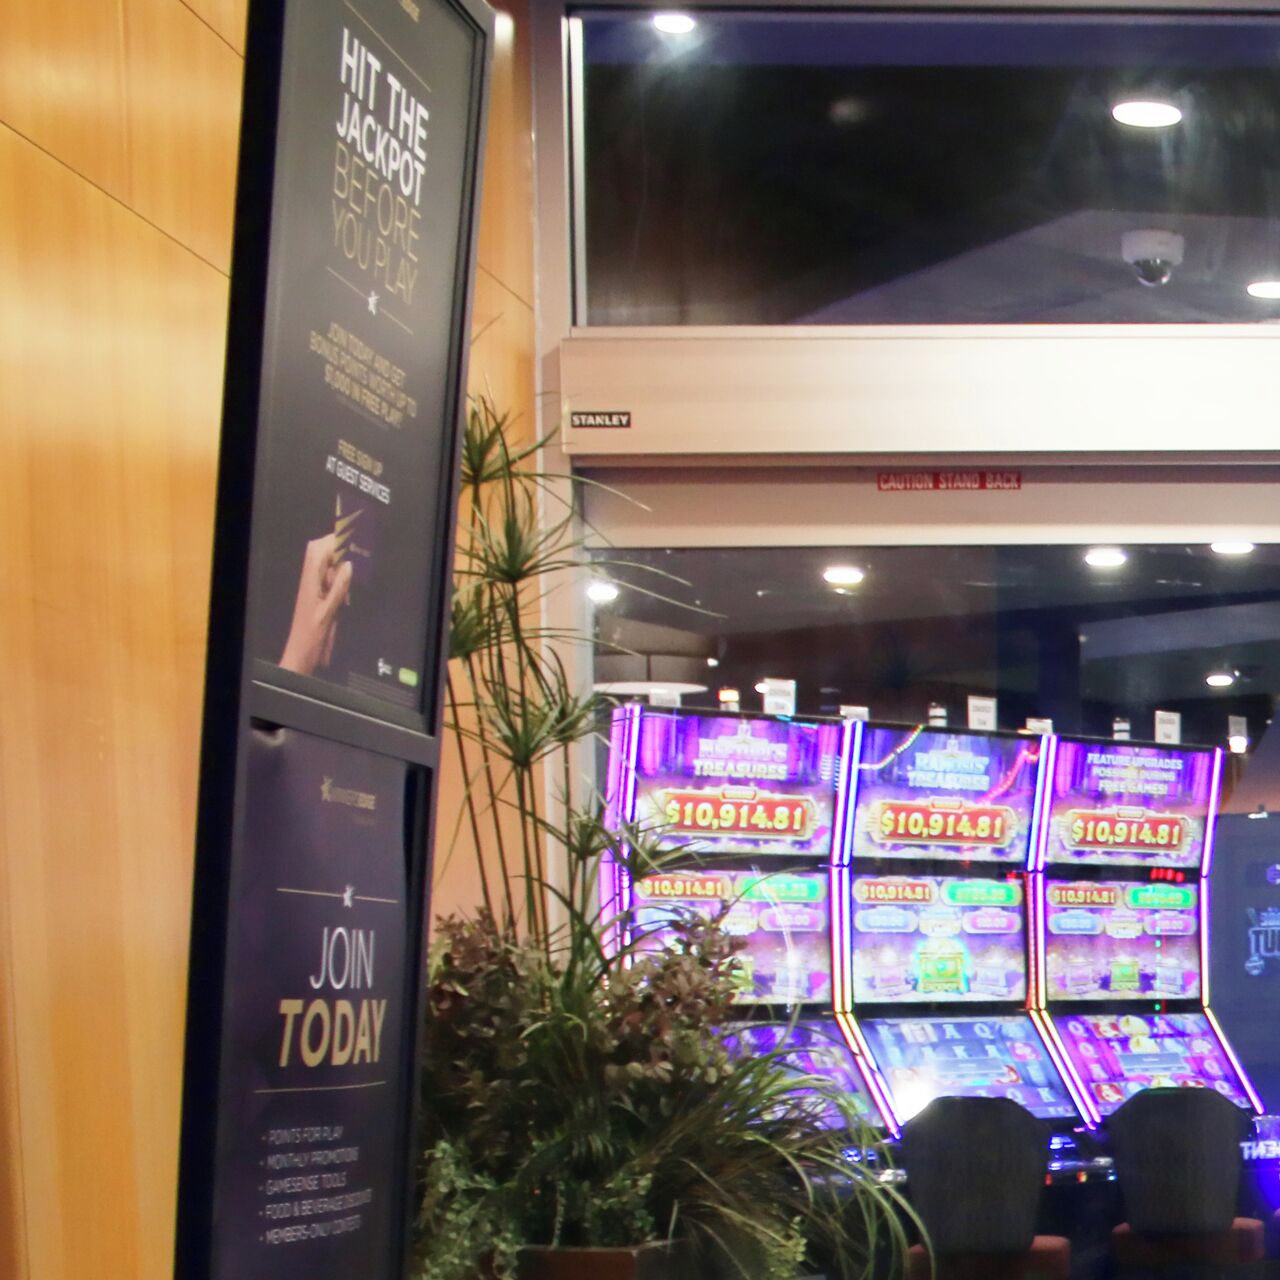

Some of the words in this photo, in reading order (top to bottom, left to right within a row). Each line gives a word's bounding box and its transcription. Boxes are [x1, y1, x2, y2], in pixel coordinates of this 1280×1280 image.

[341, 27, 381, 112] HIT
[387, 72, 429, 162] THE
[337, 92, 426, 207] JACKPOT
[333, 140, 421, 263] BEFORE
[332, 198, 371, 271] YOU
[374, 237, 418, 305] PLAY
[572, 414, 630, 427] STANLEY
[326, 455, 337, 474] AT
[337, 461, 359, 487] GUEST
[359, 472, 391, 505] SERVICES
[880, 474, 933, 490] CAUTION
[938, 474, 980, 489] STAND
[985, 473, 1020, 489] BACK
[665, 799, 803, 831] $10,914.81
[881, 809, 1003, 838] $10,914.81
[1072, 819, 1180, 845] $10,914.81
[310, 927, 374, 990] JOIN
[279, 998, 387, 1068] TODAY
